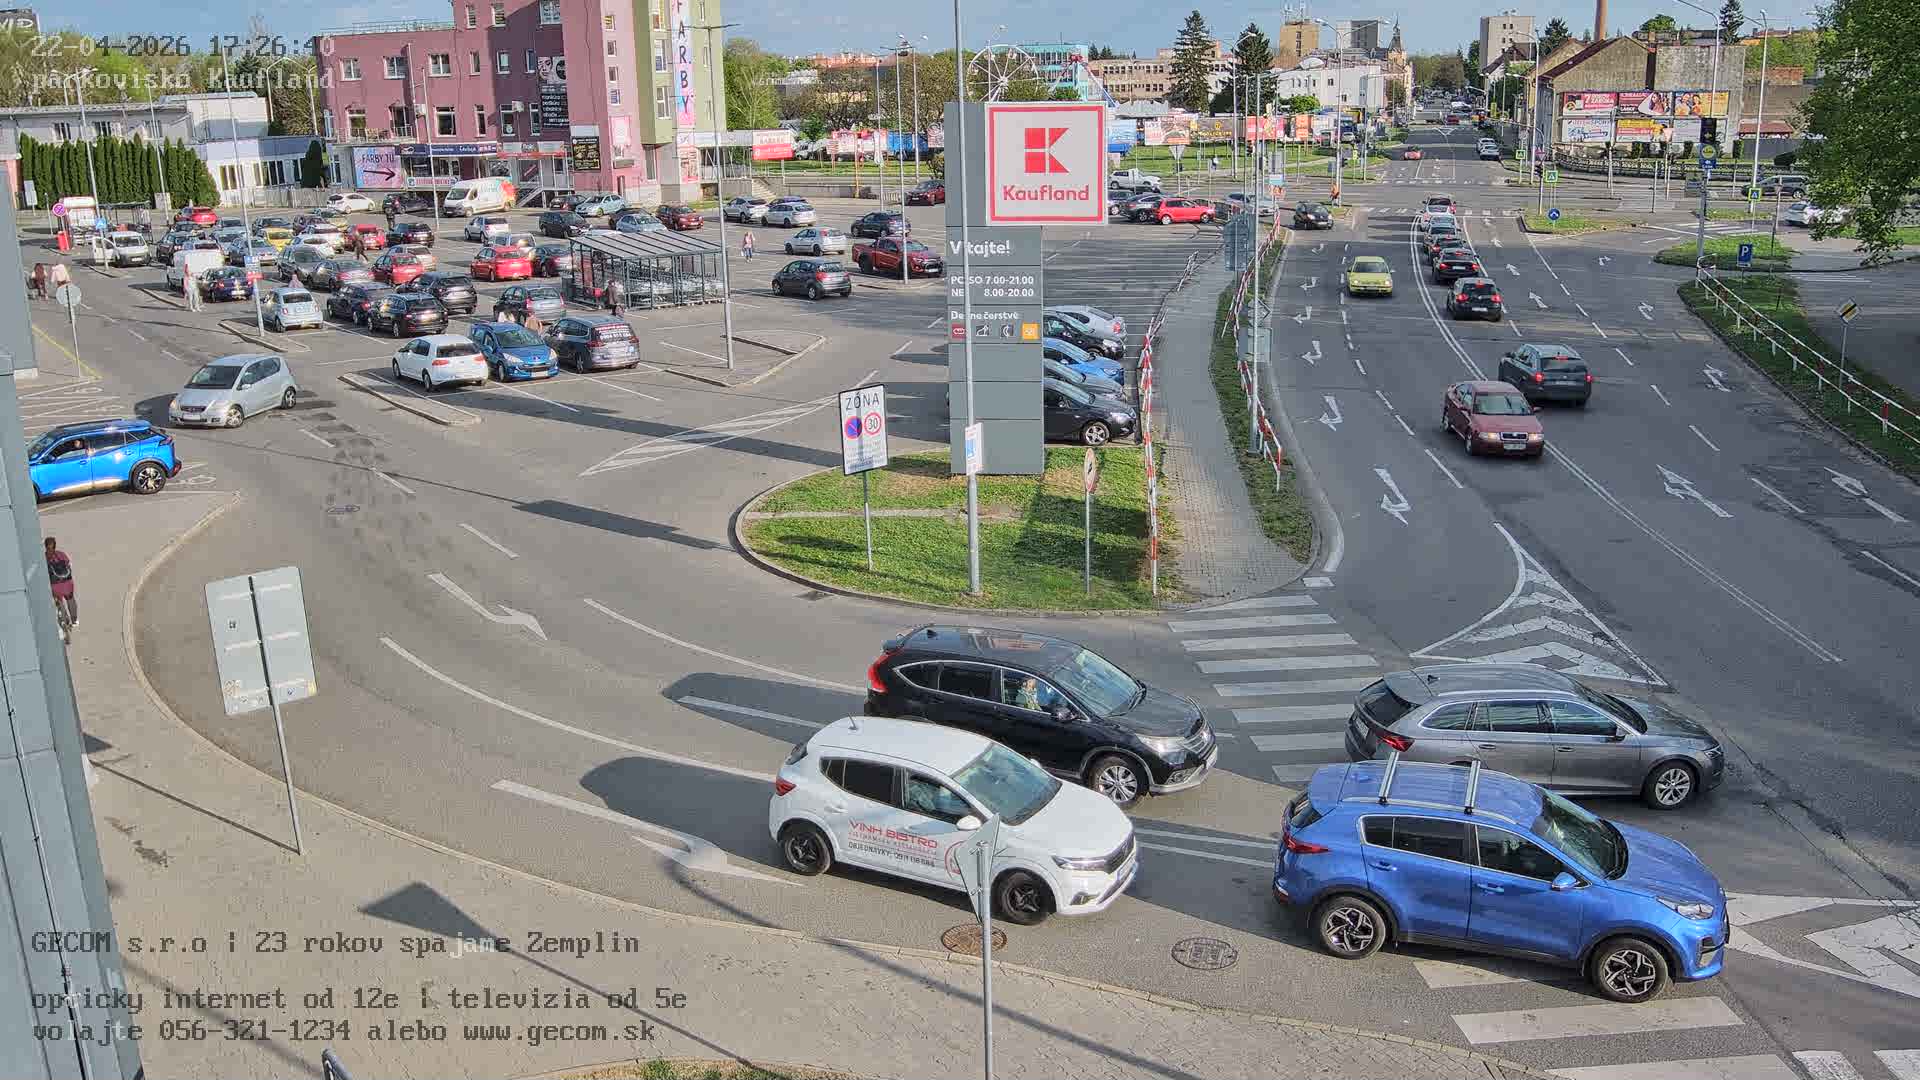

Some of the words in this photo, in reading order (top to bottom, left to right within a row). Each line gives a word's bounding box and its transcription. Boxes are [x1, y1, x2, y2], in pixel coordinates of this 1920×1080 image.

[362, 153, 384, 164] FARBY
[1003, 185, 1090, 201] Kaufland
[950, 240, 1011, 258] Vtajte!
[985, 276, 1034, 285] 7.00-21.00
[984, 288, 1034, 297] 8.00-20.00
[845, 391, 880, 411] ZÓNA
[867, 417, 879, 430] 30
[848, 818, 883, 836] VINH
[885, 829, 938, 849] BISTRO
